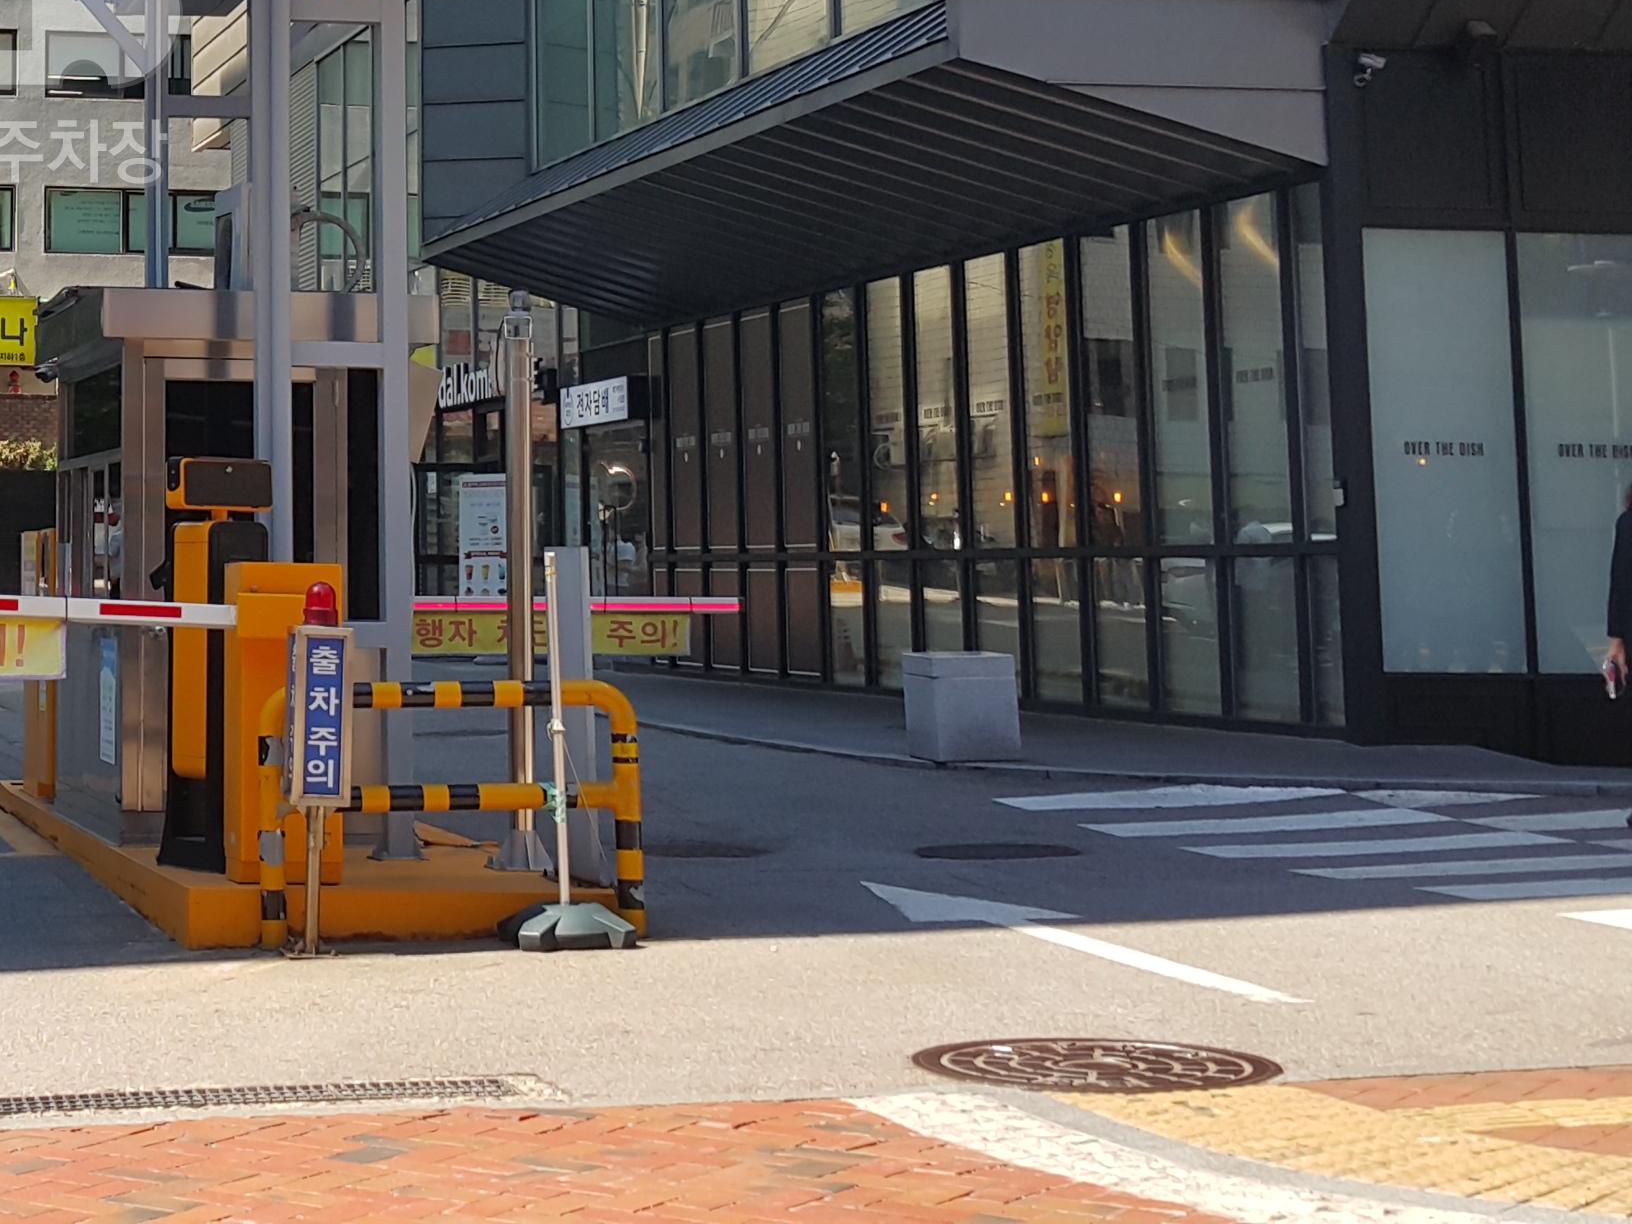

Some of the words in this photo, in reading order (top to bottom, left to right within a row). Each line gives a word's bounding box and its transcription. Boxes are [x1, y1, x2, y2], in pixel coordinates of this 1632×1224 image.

[576, 387, 610, 419] 전자담배
[1404, 441, 1430, 456] OVER
[1436, 441, 1454, 456] THE
[1459, 442, 1484, 457] DISH
[1558, 443, 1584, 458] OVER
[1589, 444, 1607, 458] THE
[415, 618, 478, 649] 행자
[607, 619, 680, 649] 주의!
